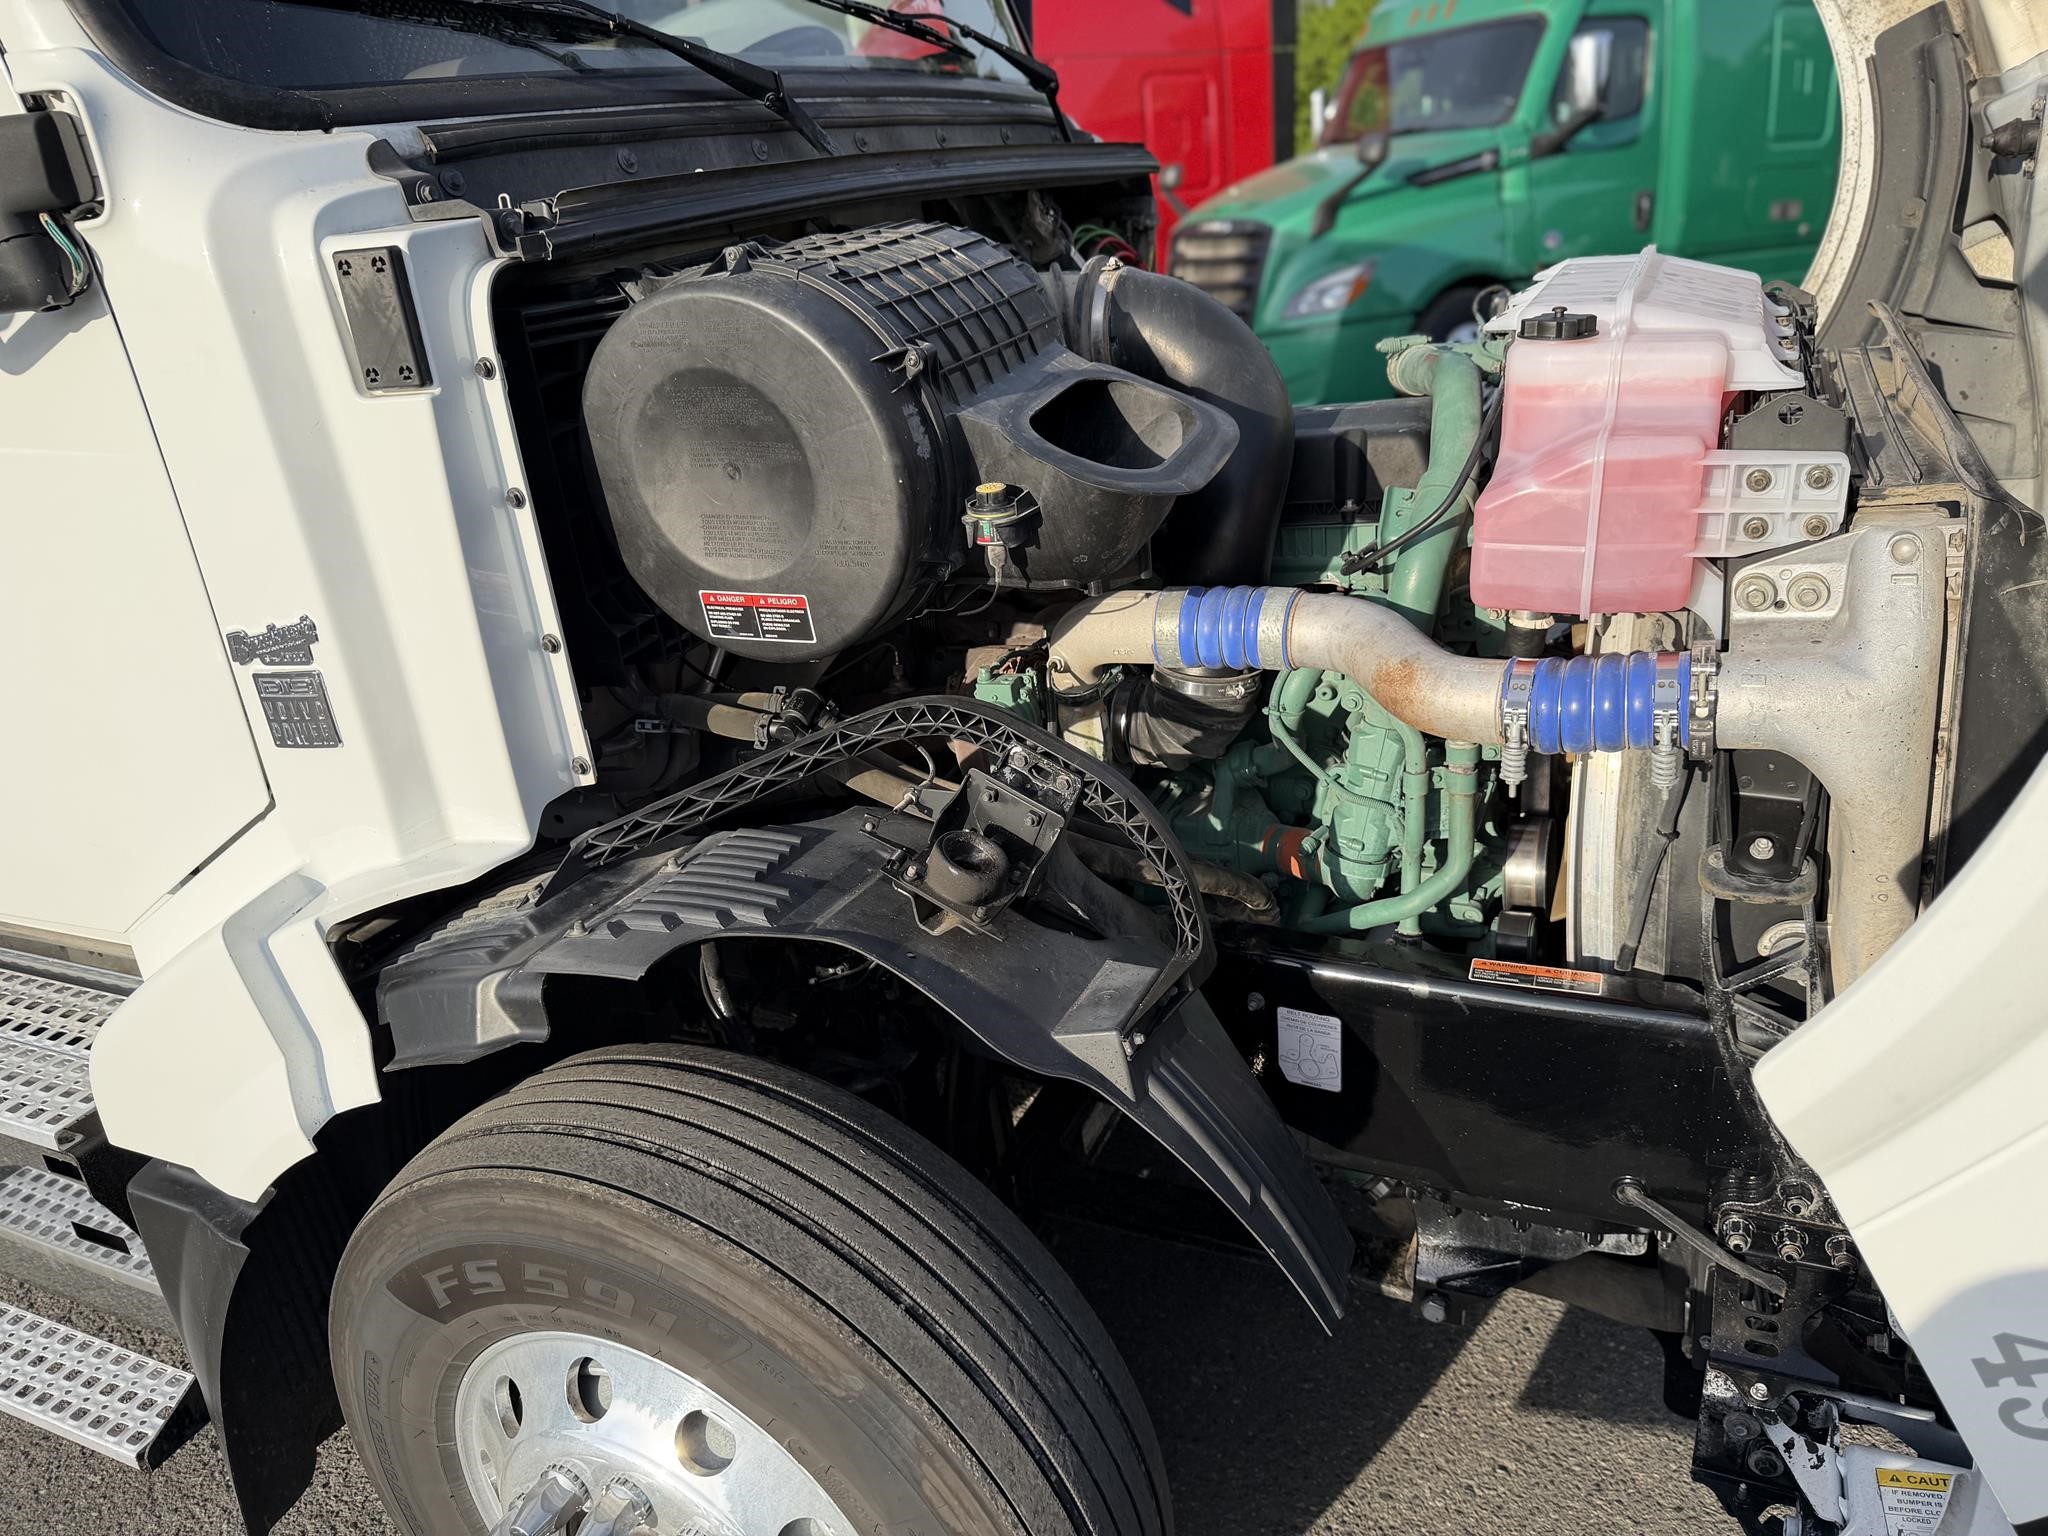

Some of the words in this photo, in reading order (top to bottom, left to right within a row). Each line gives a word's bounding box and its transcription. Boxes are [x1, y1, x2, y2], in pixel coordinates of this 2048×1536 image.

[716, 595, 746, 604] DANGER
[767, 597, 798, 606] PELIGRO
[263, 700, 326, 720] VOLVO
[271, 721, 335, 745] POWER
[1489, 962, 1528, 970] WARNING
[1302, 1013, 1330, 1021] ROUTING
[1896, 1498, 1933, 1507] BUMPER
[1887, 1505, 1923, 1514] BEFORE
[1901, 1516, 1932, 1525] LOCKED
